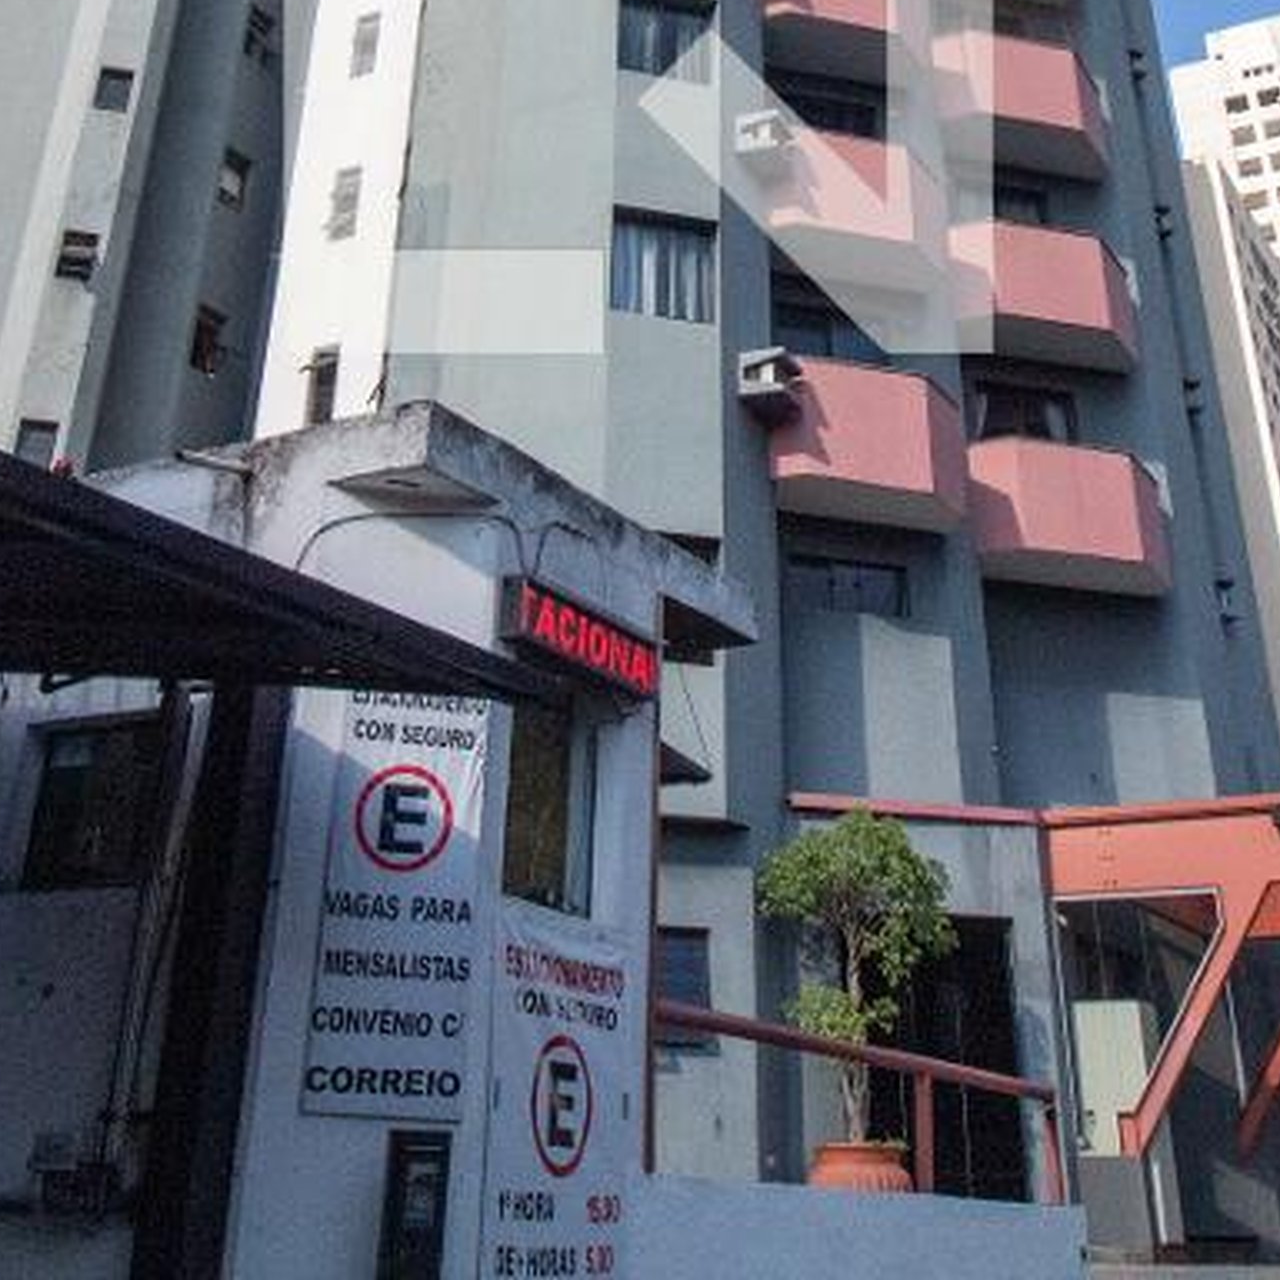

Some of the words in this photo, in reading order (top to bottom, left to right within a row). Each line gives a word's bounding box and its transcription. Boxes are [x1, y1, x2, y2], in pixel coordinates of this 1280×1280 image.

[401, 723, 477, 751] SEGURO
[378, 783, 429, 854] E
[324, 889, 400, 920] VAGAS
[411, 895, 472, 924] PARA
[323, 949, 471, 982] MENSALISTAS
[311, 1006, 434, 1038] CONVENIO
[305, 1065, 461, 1098] CORREIO
[547, 1058, 577, 1148] E
